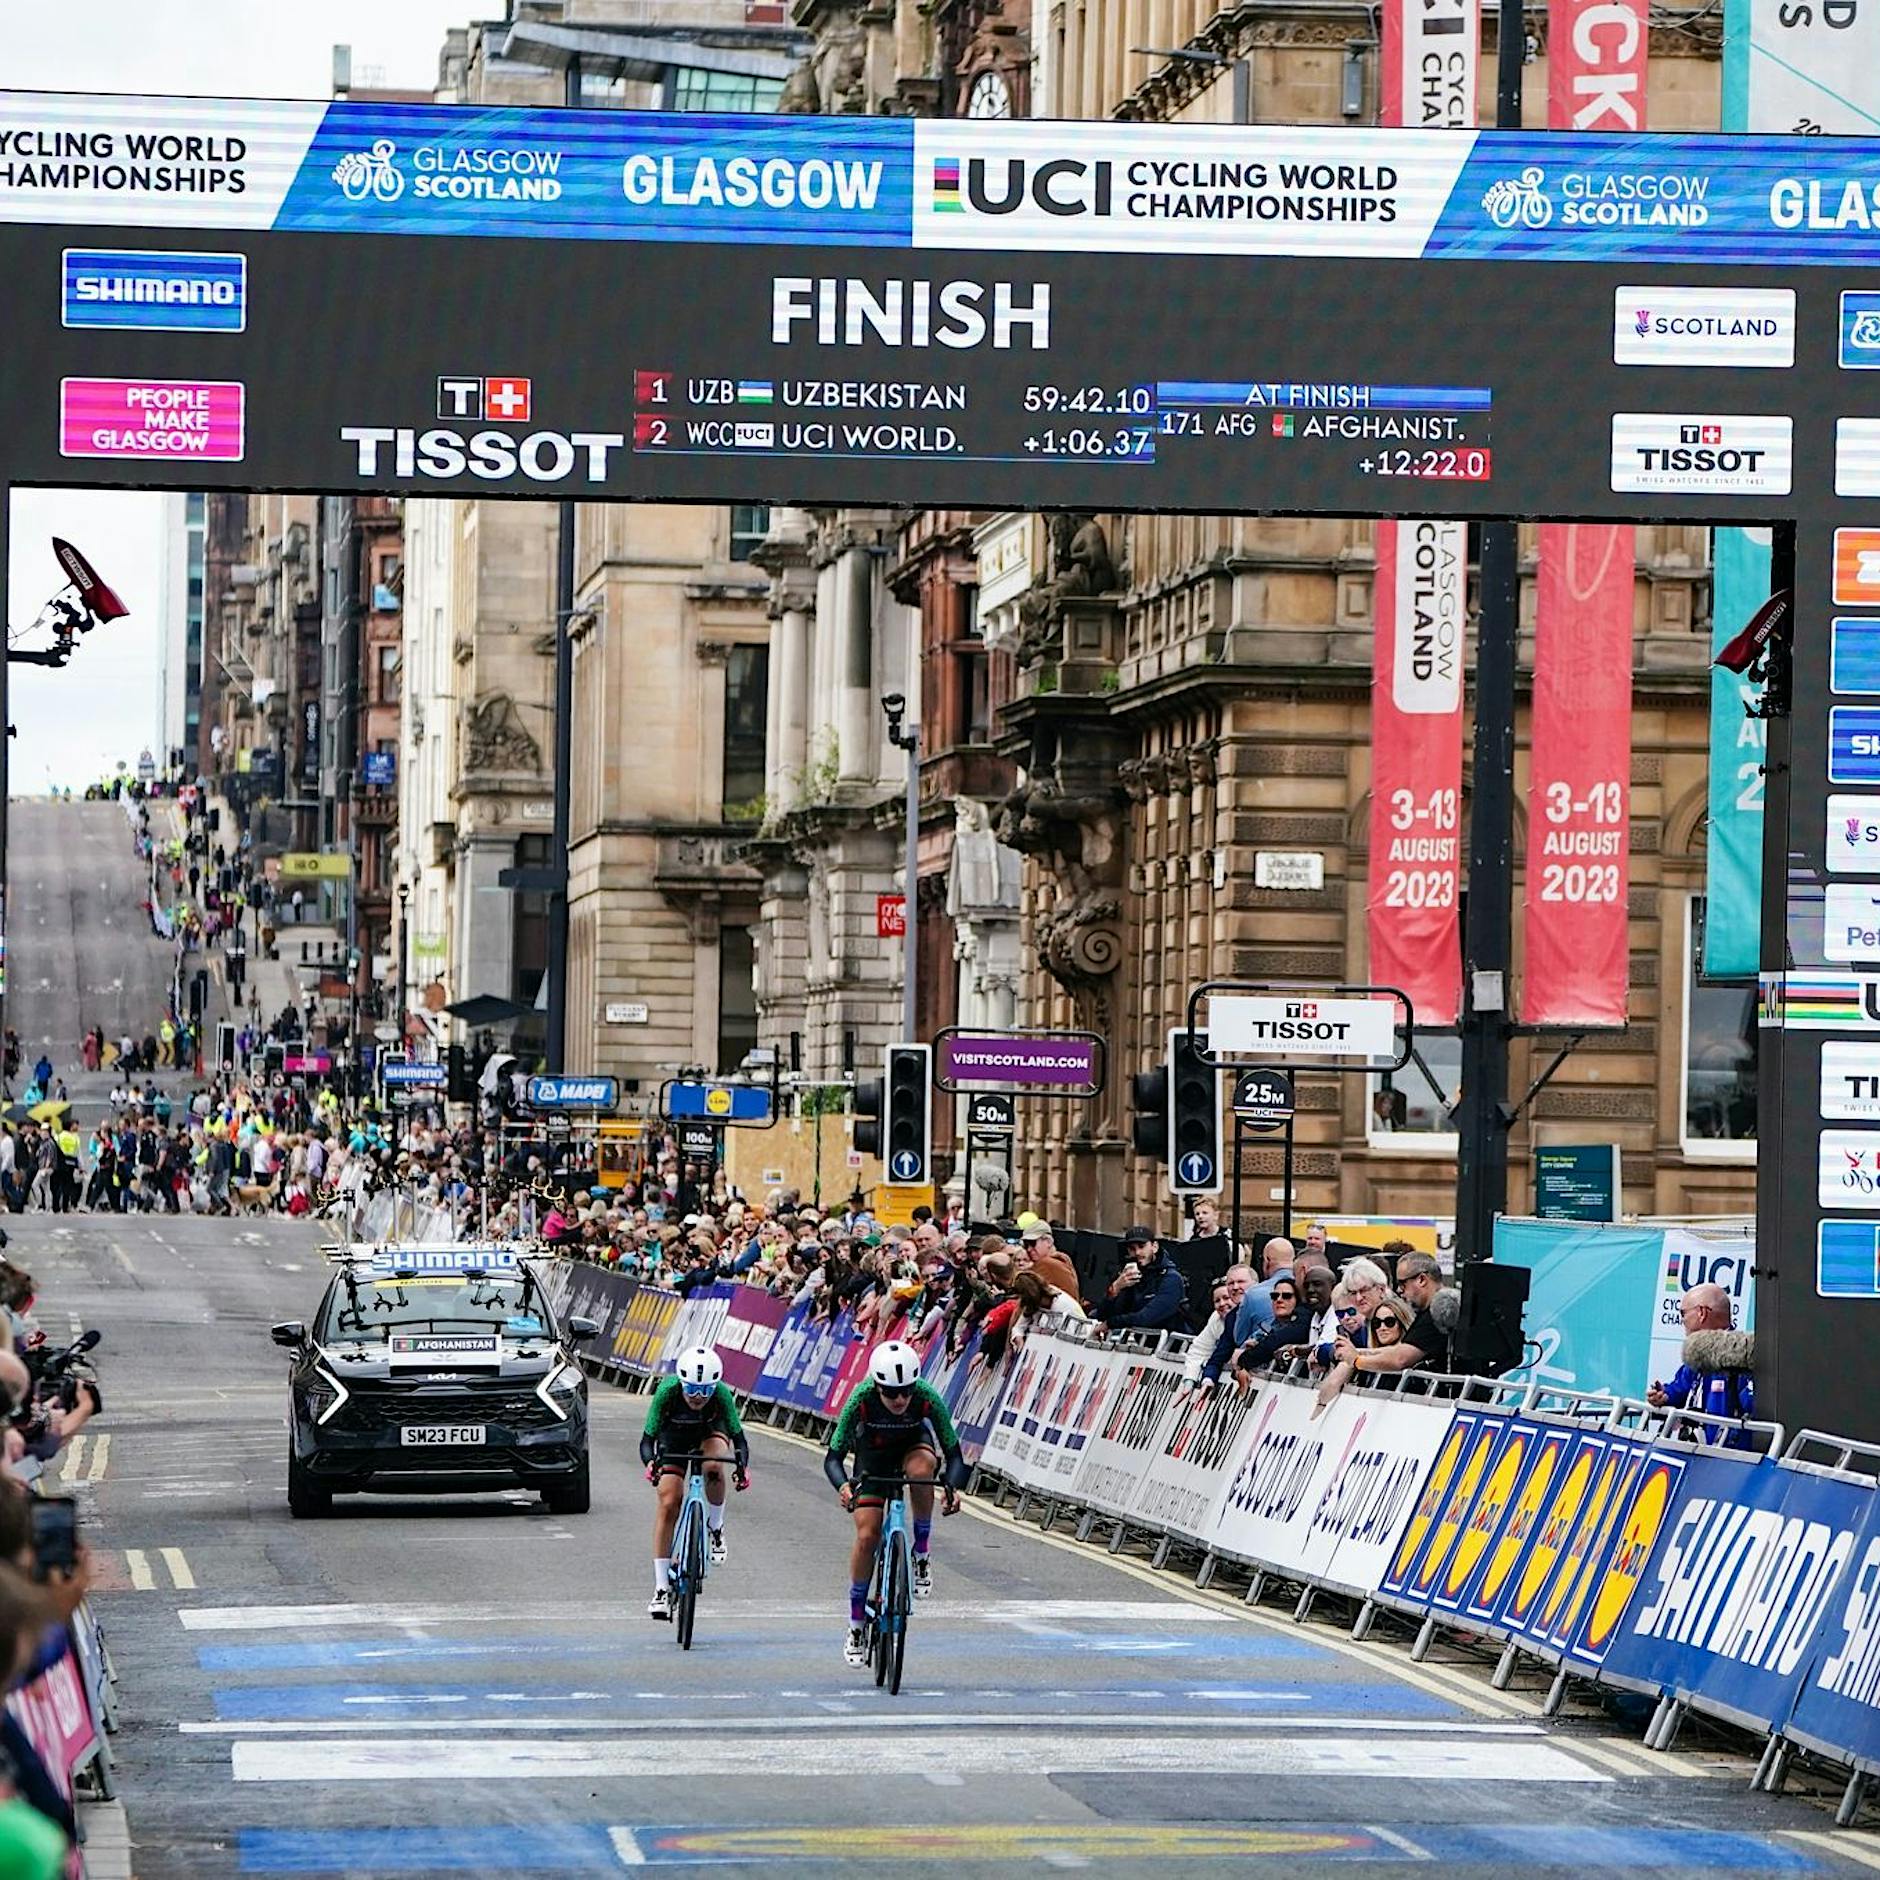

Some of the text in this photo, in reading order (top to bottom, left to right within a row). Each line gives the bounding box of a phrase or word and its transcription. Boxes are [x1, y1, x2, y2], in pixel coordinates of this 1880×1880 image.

[1422, 53, 1442, 127] CHA
[0, 130, 246, 162] YCLING WORLD
[413, 148, 561, 174] GLASGOW
[413, 175, 561, 200] SCOTLAND
[622, 155, 883, 209] GLASGOW
[968, 158, 1112, 217] UCI
[1127, 161, 1397, 191] CYCLING WORLD
[1562, 174, 1710, 201] GLASGOW
[1127, 193, 1397, 222] CHAMPIONSHIPS
[1562, 202, 1709, 226] SCOTLAND
[76, 277, 234, 305] SHIMANO
[772, 277, 1051, 349] FINISH
[1656, 318, 1777, 336] SCOTLAND
[127, 388, 209, 409] PEOPLE
[444, 382, 478, 416] T
[650, 379, 1150, 415] 1 UZB UZBEKISTAN 59:42.10
[1245, 384, 1371, 408] AT FINISH
[145, 410, 209, 430] MAKE
[1162, 413, 1467, 440] 171 AFG AFGHANIST.
[92, 430, 208, 452] GLASGOW
[651, 421, 668, 445] 2
[686, 422, 734, 447] WCC
[782, 424, 834, 448] UCI
[844, 426, 965, 453] WORLD.
[1023, 429, 1150, 456] +1:06.37
[341, 428, 624, 482] TISSOT
[1359, 450, 1485, 478] +12:22.0
[1637, 448, 1765, 472] TISSOT
[1412, 523, 1436, 681] COTLAND
[1438, 521, 1457, 681] LASGOW
[1390, 789, 1456, 830] 3-13
[1545, 782, 1622, 825] 3-13
[1388, 837, 1455, 862] AUGUST
[1543, 831, 1621, 856] AUGUST
[1385, 870, 1455, 908] 2023
[1541, 865, 1620, 902] 2023
[1252, 1021, 1350, 1040] TISSOT
[385, 1067, 443, 1080] SHIMANO
[952, 1052, 1088, 1070] VISITSCOTLAND.COM
[560, 1084, 608, 1100] MAPEI
[1245, 1082, 1285, 1105] 25M
[976, 1105, 1008, 1123] 50M
[371, 1251, 518, 1270] SHIMANO
[1679, 1253, 1747, 1298] UCI
[416, 1339, 494, 1351] AFGHANISTAN
[407, 1430, 480, 1443] SM23 FCU
[1634, 1499, 1856, 1675] SHIMANO
